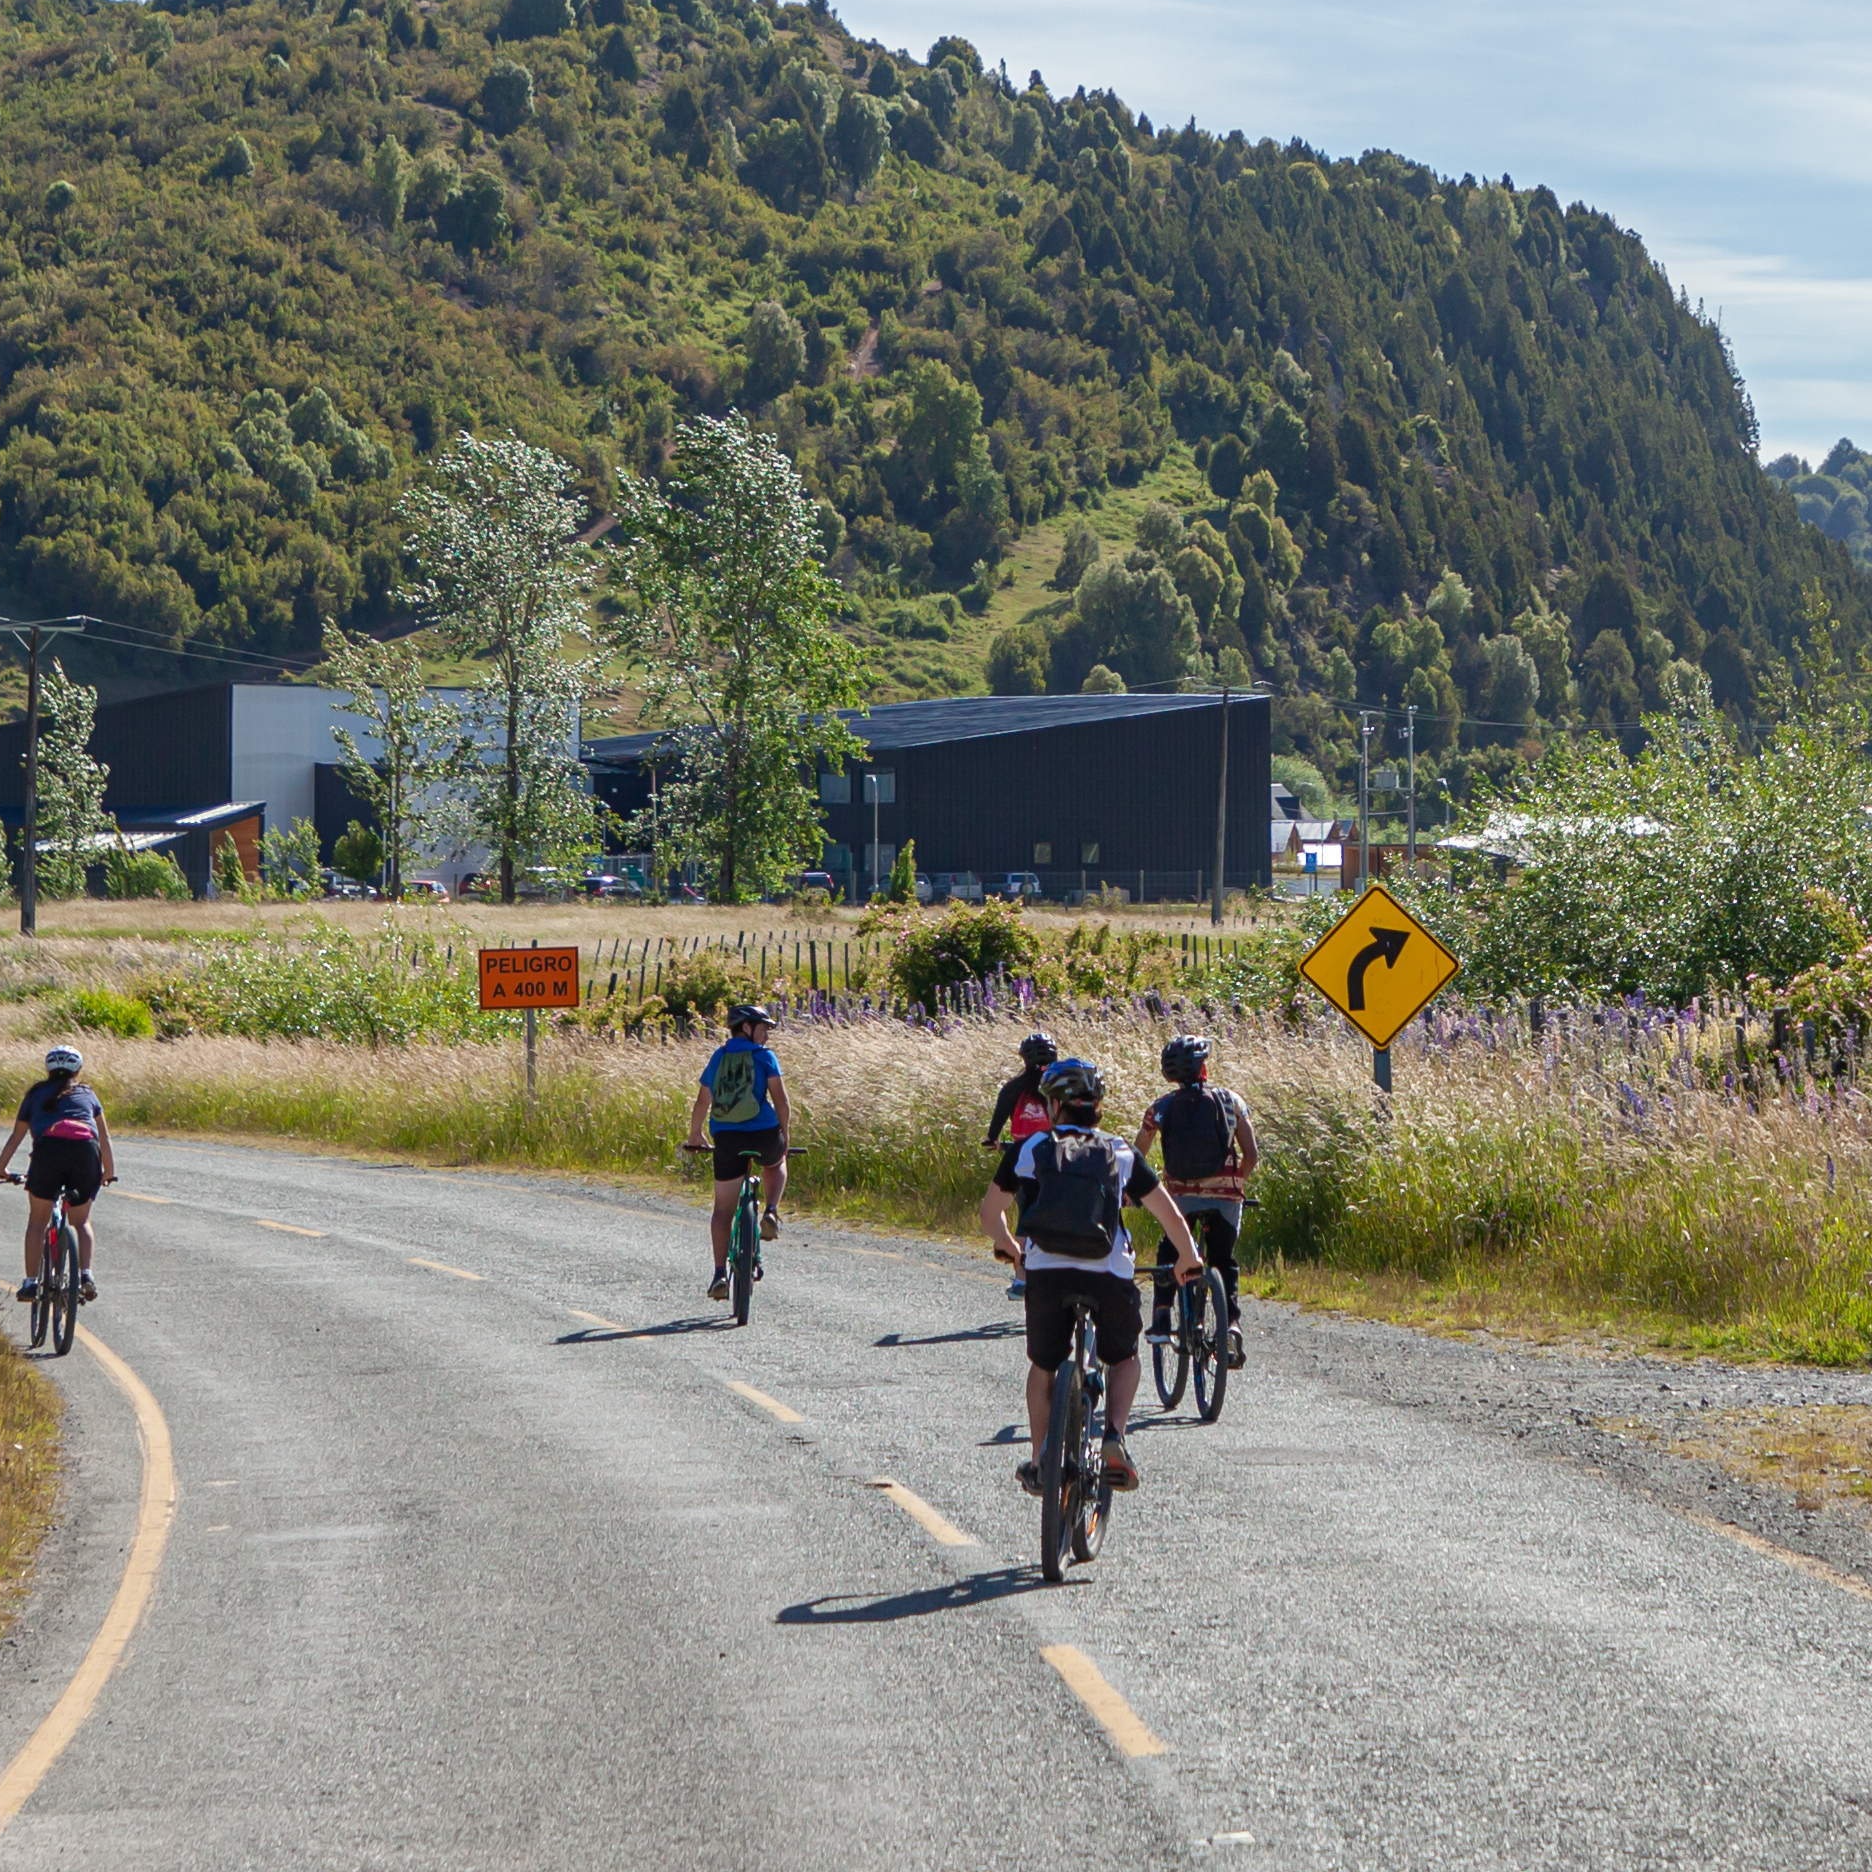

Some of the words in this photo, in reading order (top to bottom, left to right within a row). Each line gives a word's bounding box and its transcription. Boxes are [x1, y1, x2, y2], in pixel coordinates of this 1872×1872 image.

[486, 956, 572, 974] PELIGRO
[493, 983, 506, 998] A
[514, 981, 546, 997] 400
[553, 981, 568, 996] M
